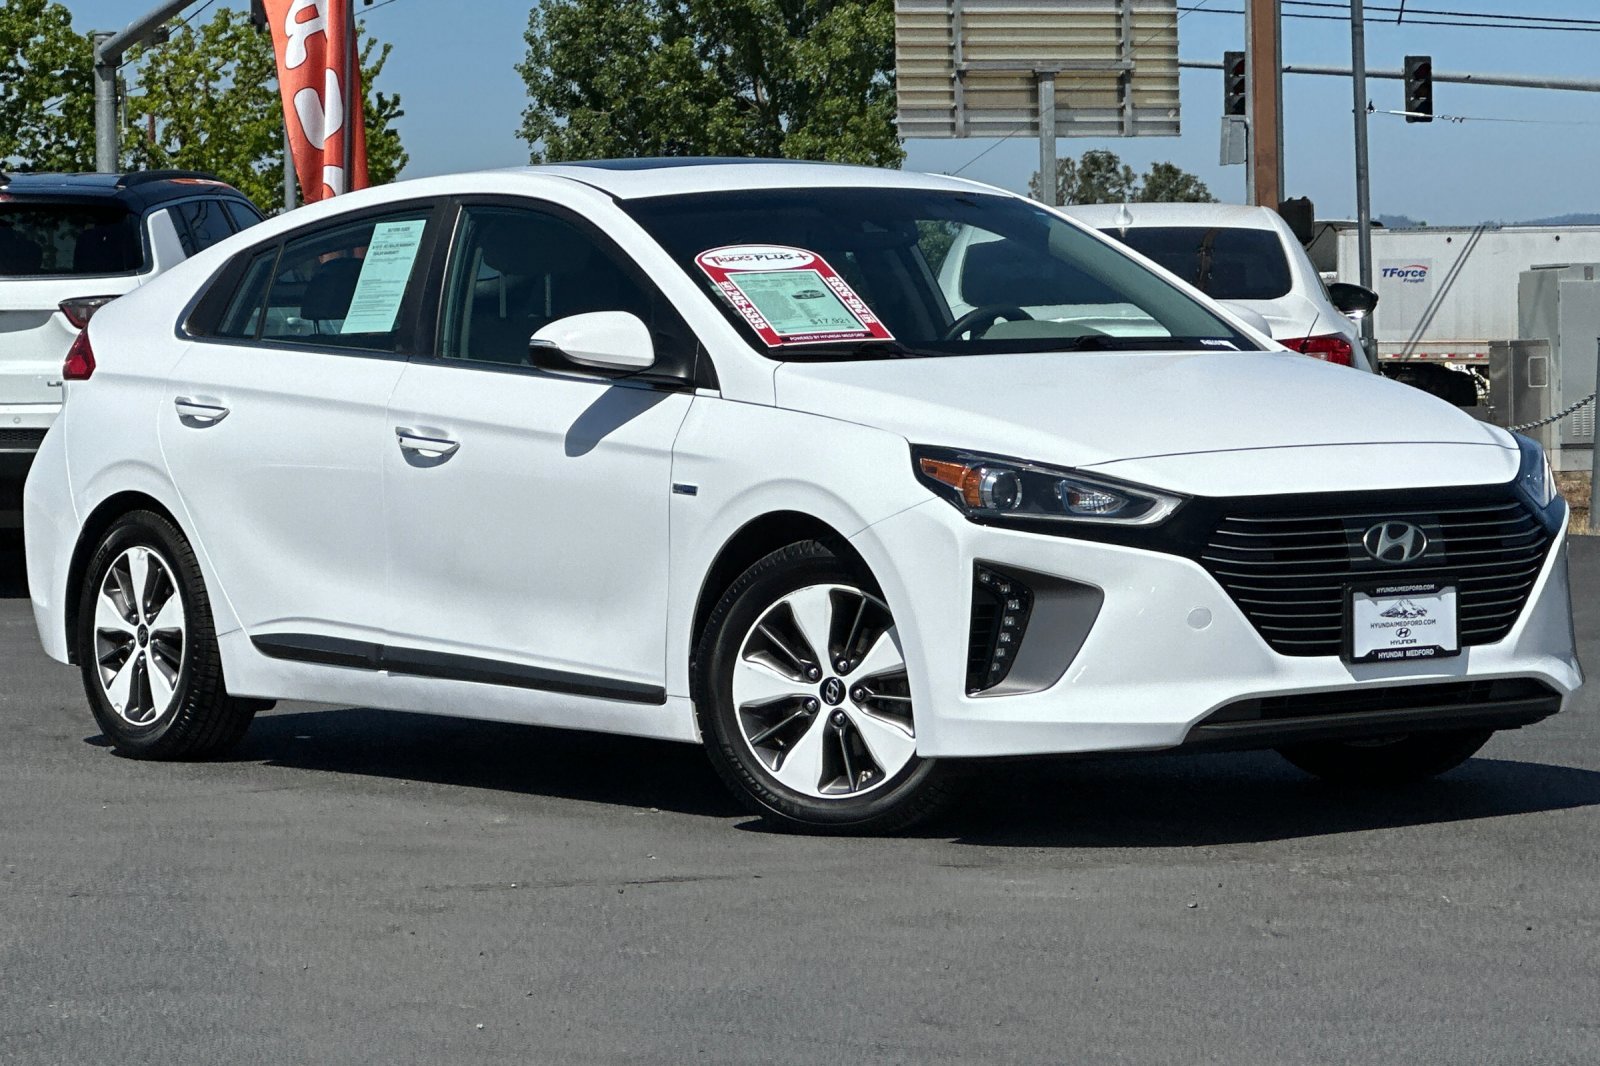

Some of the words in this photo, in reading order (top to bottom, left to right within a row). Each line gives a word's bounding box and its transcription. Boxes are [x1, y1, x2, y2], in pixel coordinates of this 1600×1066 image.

[1382, 268, 1426, 278] TForce
[1376, 584, 1435, 593] HYUNDAIMEDFORD.COM
[1370, 619, 1436, 629] HYUNDAIMEDFORD.COM
[1378, 650, 1404, 659] HYUNDAI
[1406, 648, 1434, 657] MEDFORD
